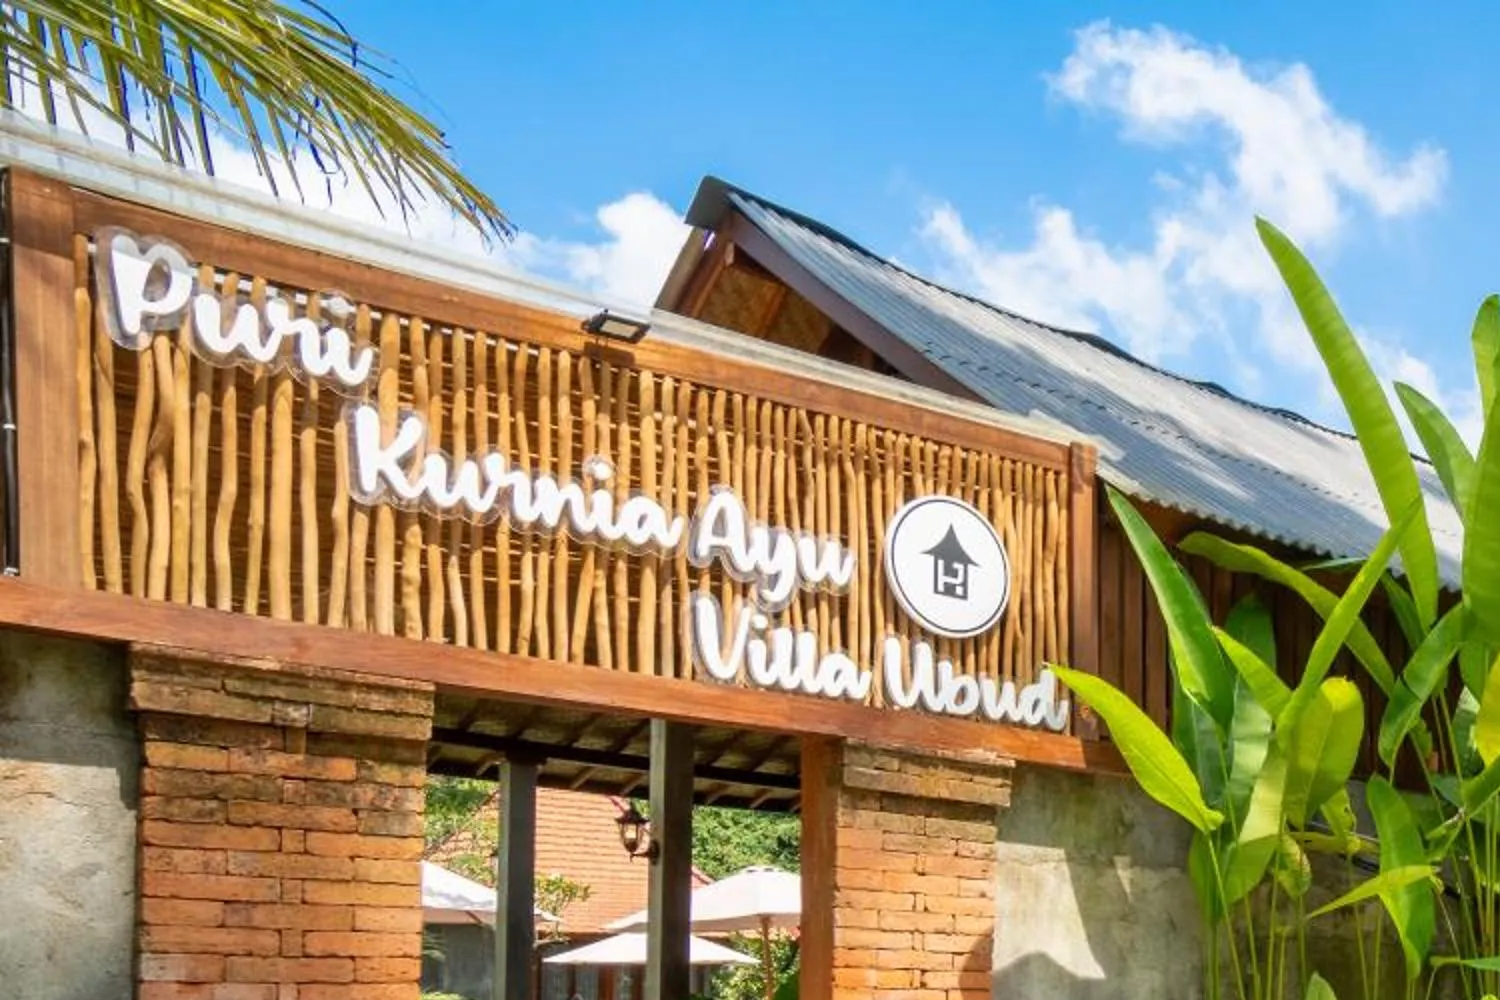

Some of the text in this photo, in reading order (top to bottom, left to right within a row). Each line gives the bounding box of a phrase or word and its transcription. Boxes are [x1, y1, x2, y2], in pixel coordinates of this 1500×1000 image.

[108, 232, 373, 386] Puri
[352, 404, 855, 602] Kurnia Ayu
[694, 596, 1069, 731] Villa Ubud
